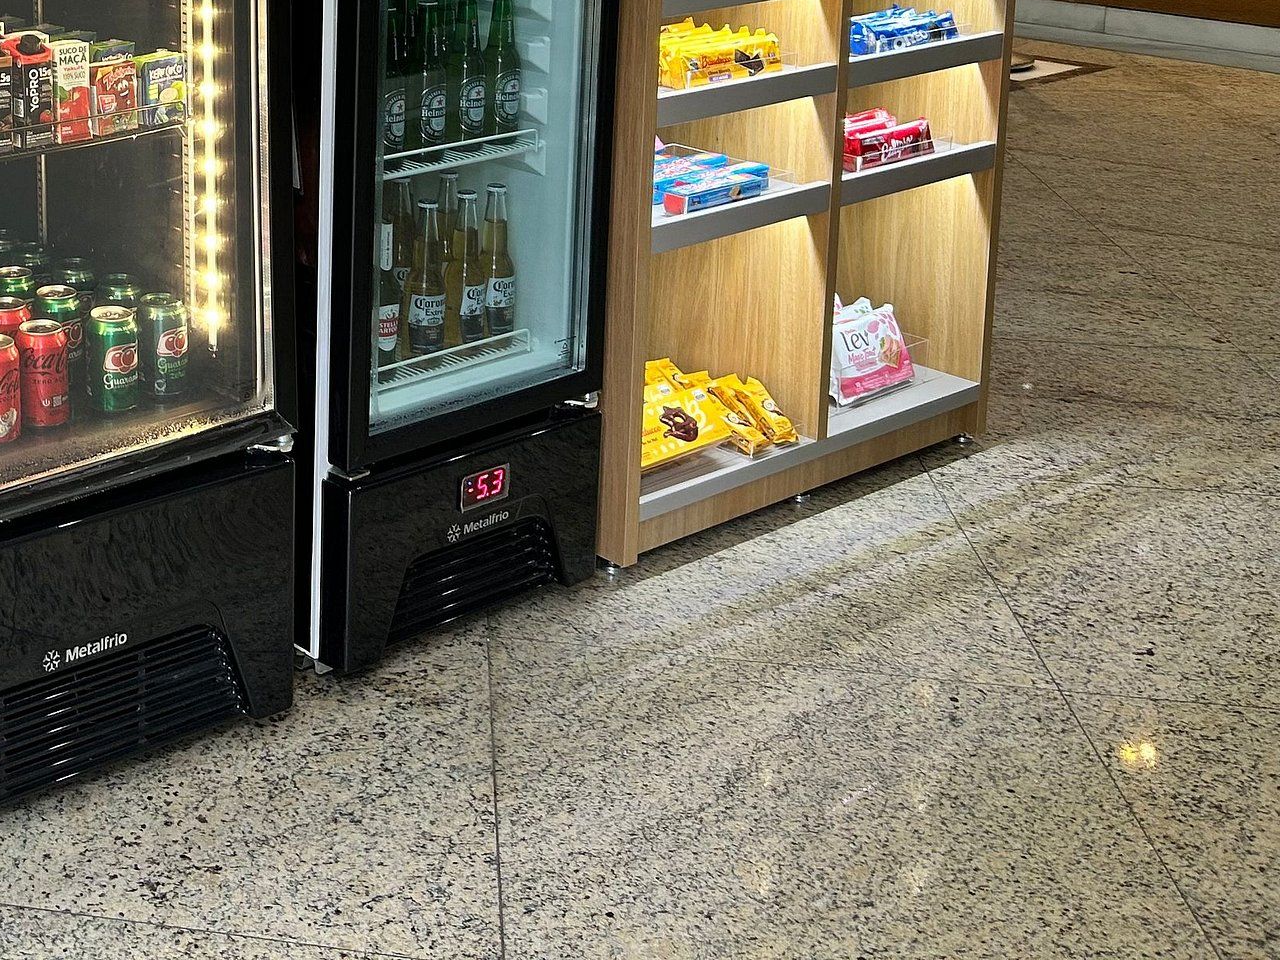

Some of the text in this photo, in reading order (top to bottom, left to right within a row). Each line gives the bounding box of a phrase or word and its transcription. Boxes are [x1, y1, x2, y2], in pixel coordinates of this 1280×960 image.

[58, 45, 87, 56] SUCO DE
[58, 53, 88, 66] MAÇÃ
[463, 510, 509, 535] Metalfrio
[65, 633, 128, 663] Metalfrio
